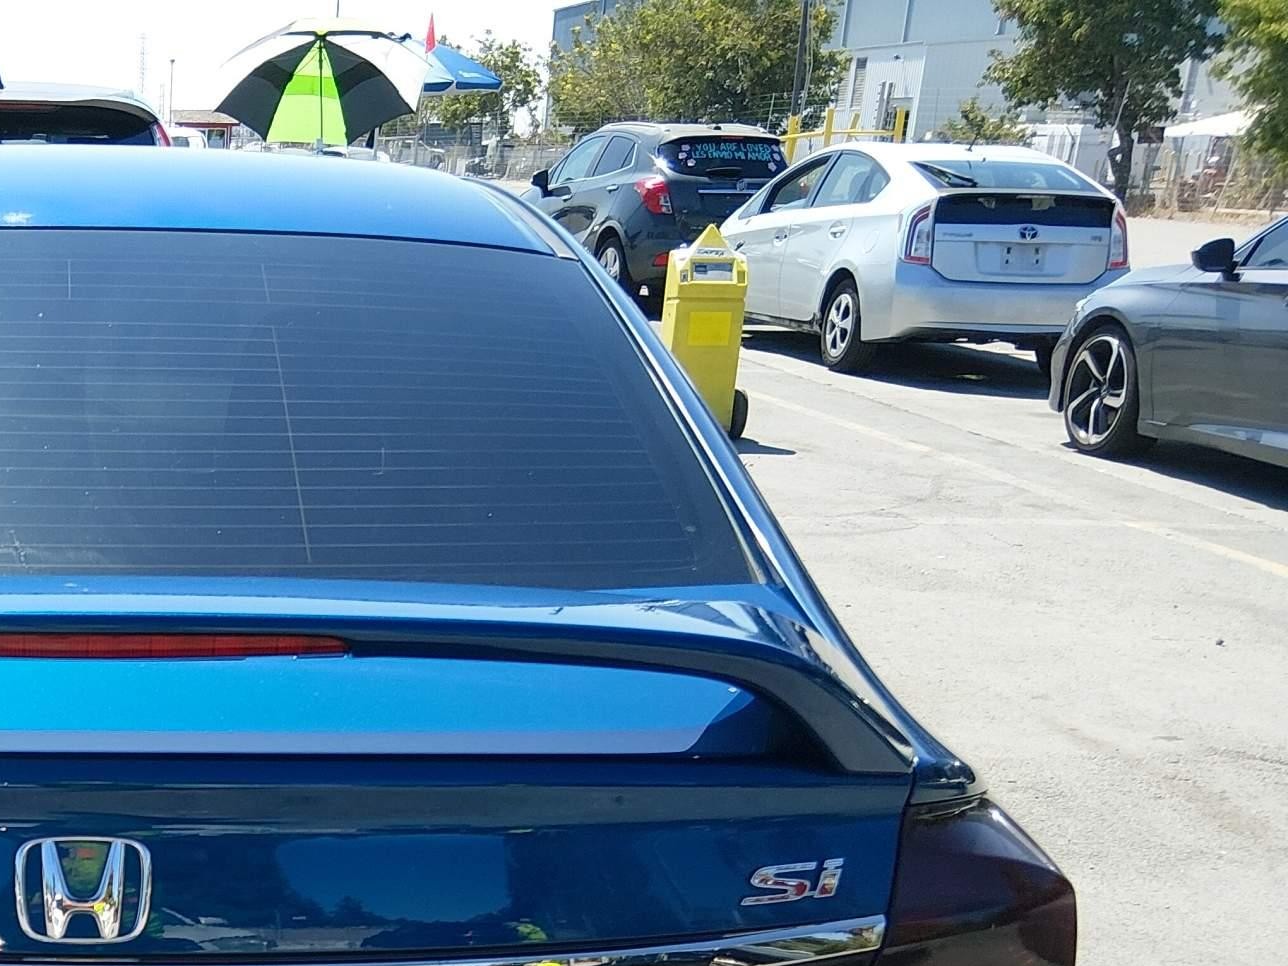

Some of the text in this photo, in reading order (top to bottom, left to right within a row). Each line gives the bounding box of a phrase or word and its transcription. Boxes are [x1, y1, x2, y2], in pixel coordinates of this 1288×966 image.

[696, 143, 716, 152] YOU
[740, 143, 772, 153] LOVED
[740, 858, 844, 906] Si
